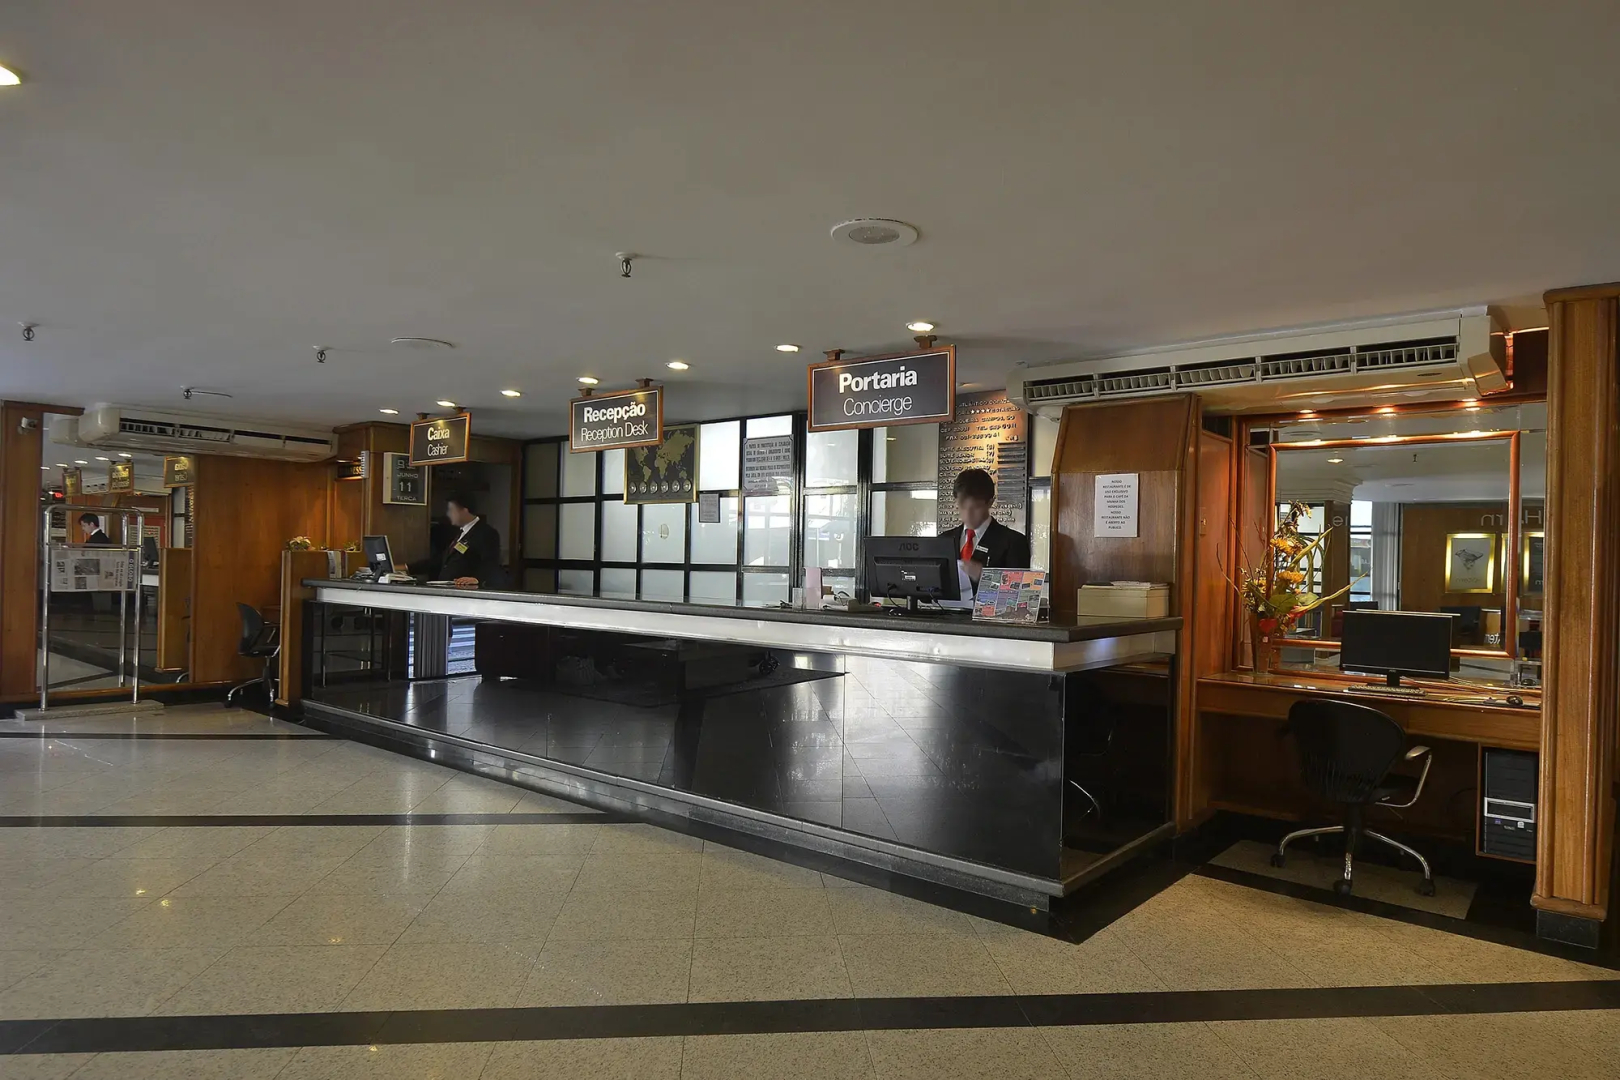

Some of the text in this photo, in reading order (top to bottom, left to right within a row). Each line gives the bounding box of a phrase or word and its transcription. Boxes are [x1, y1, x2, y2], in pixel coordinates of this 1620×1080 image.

[839, 366, 917, 393] Portaria
[583, 401, 645, 424] Recepção
[843, 395, 912, 416] Concierge
[427, 426, 450, 441] Caixa
[581, 420, 649, 442] Reception Desk
[427, 442, 449, 456] Cashier
[399, 481, 412, 492] 11
[899, 543, 919, 551] AOC
